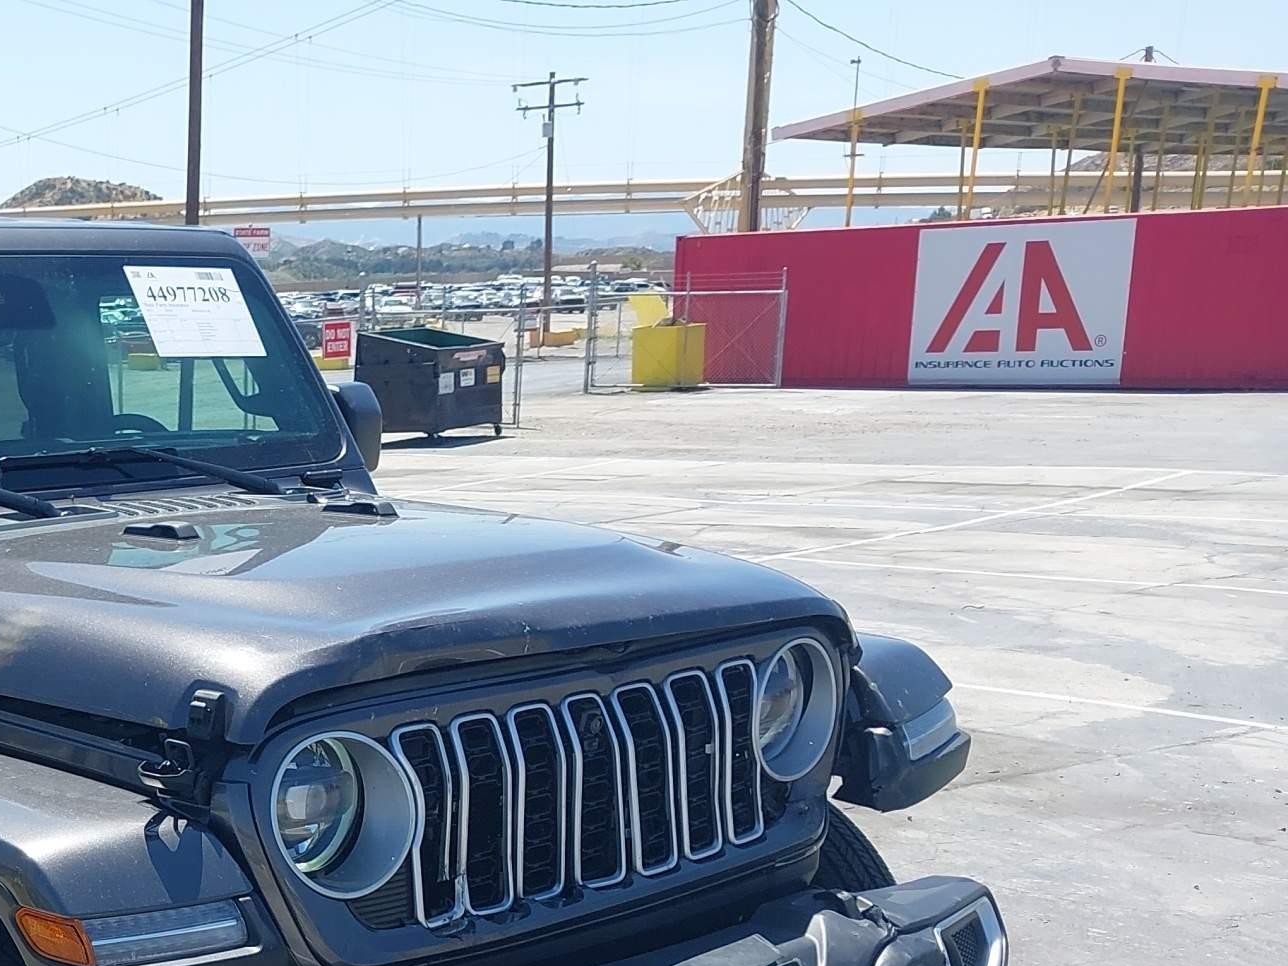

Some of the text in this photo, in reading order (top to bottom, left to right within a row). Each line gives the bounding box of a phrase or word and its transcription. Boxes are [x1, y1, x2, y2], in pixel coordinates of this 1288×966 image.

[146, 285, 230, 303] 44977208
[325, 327, 350, 340] DO NOT
[326, 340, 348, 352] ENTER
[915, 358, 1115, 369] INSURANCE AUTO AUCTIONS
